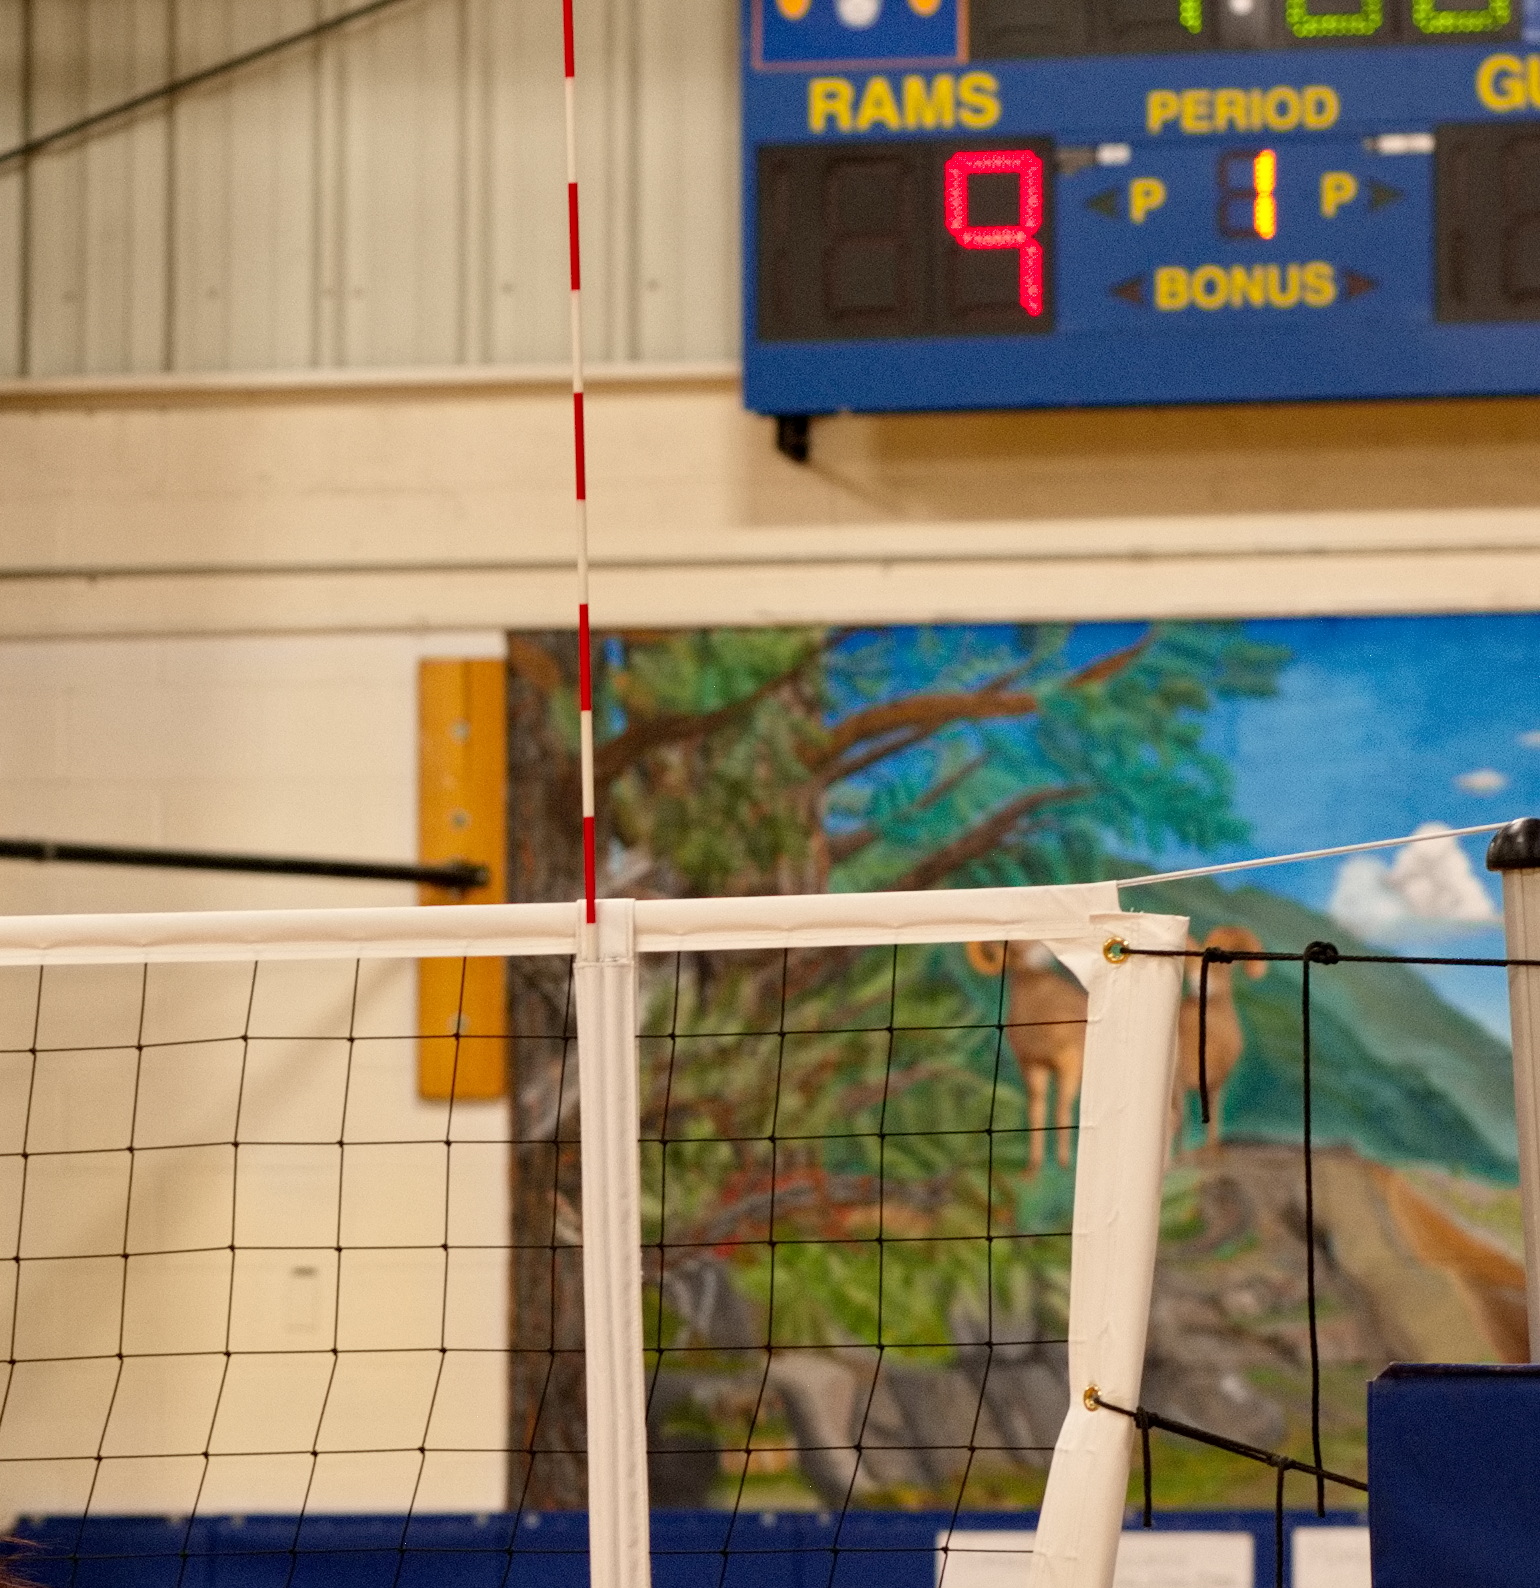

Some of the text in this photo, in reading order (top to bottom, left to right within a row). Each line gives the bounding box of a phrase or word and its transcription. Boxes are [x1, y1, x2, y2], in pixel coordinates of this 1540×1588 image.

[808, 72, 1001, 132] RAMS
[1146, 84, 1340, 134] PERIOD
[1130, 177, 1166, 224] P
[1253, 149, 1277, 238] 1
[1320, 171, 1358, 217] P
[945, 150, 1043, 316] 9
[1154, 262, 1337, 312] BONUS
